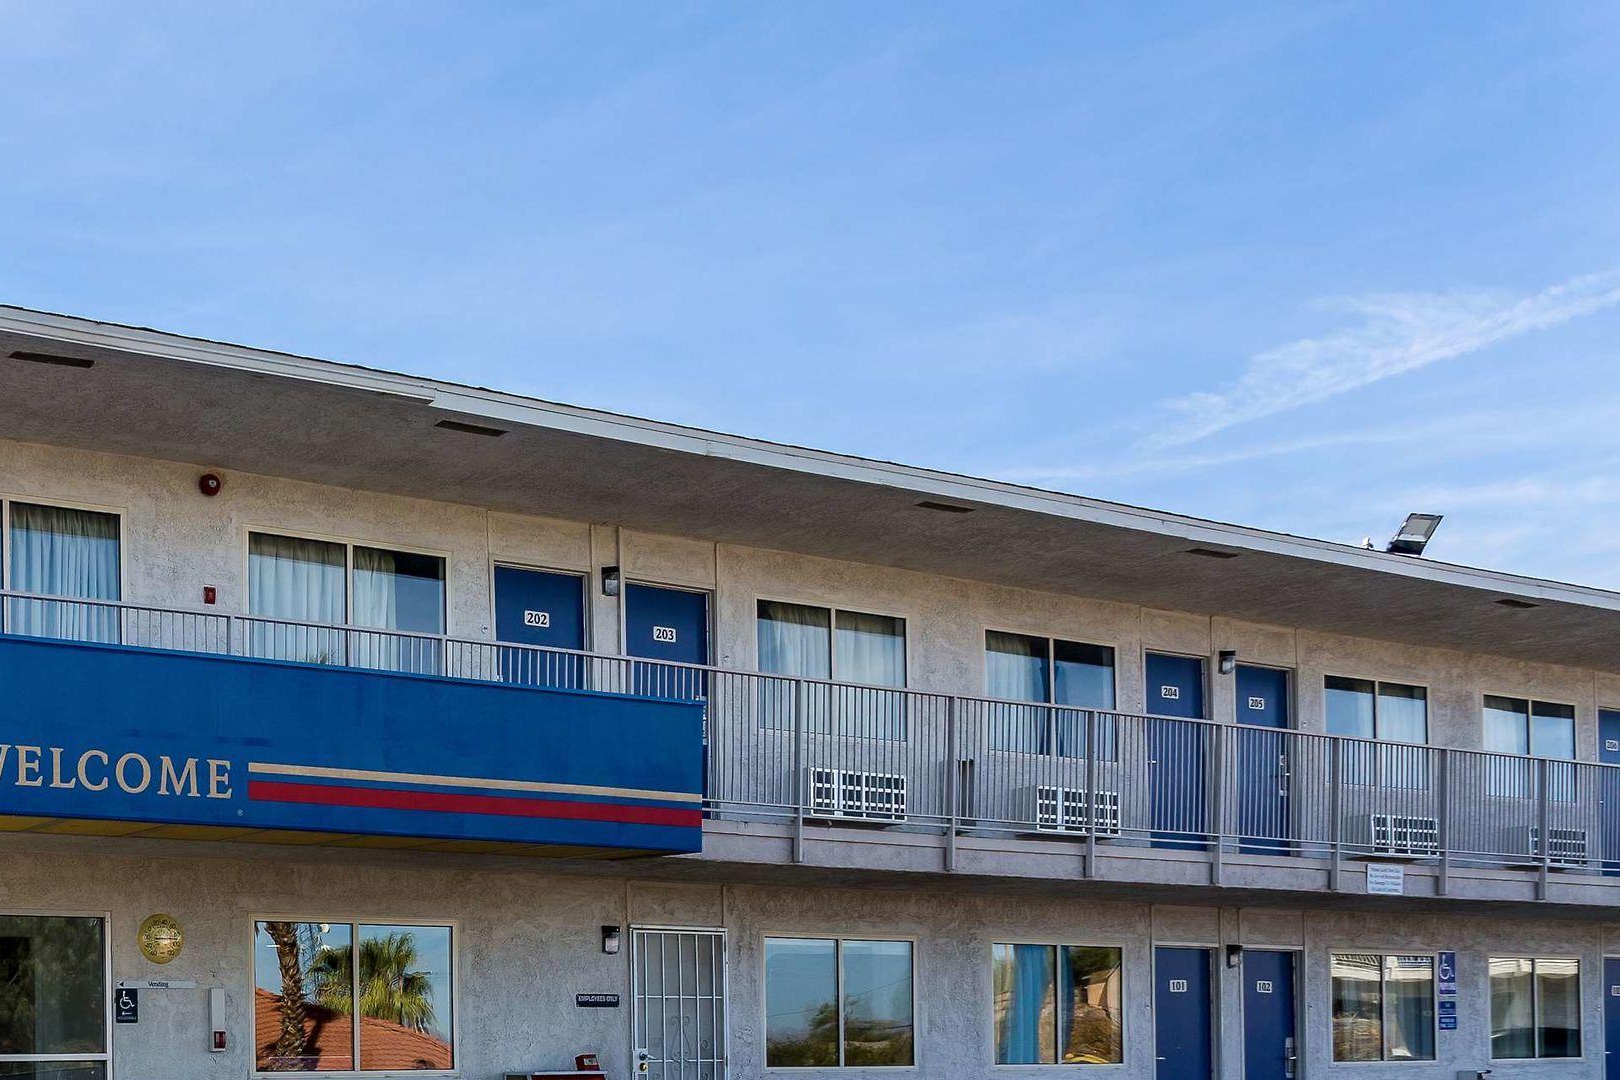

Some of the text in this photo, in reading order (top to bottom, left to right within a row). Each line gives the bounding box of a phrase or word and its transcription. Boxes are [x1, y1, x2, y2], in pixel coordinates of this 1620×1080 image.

[526, 612, 548, 625] 202
[655, 628, 675, 641] 203
[1163, 687, 1178, 698] 204
[1250, 698, 1263, 708] 205
[1172, 981, 1185, 991] 101
[1258, 982, 1271, 991] 102
